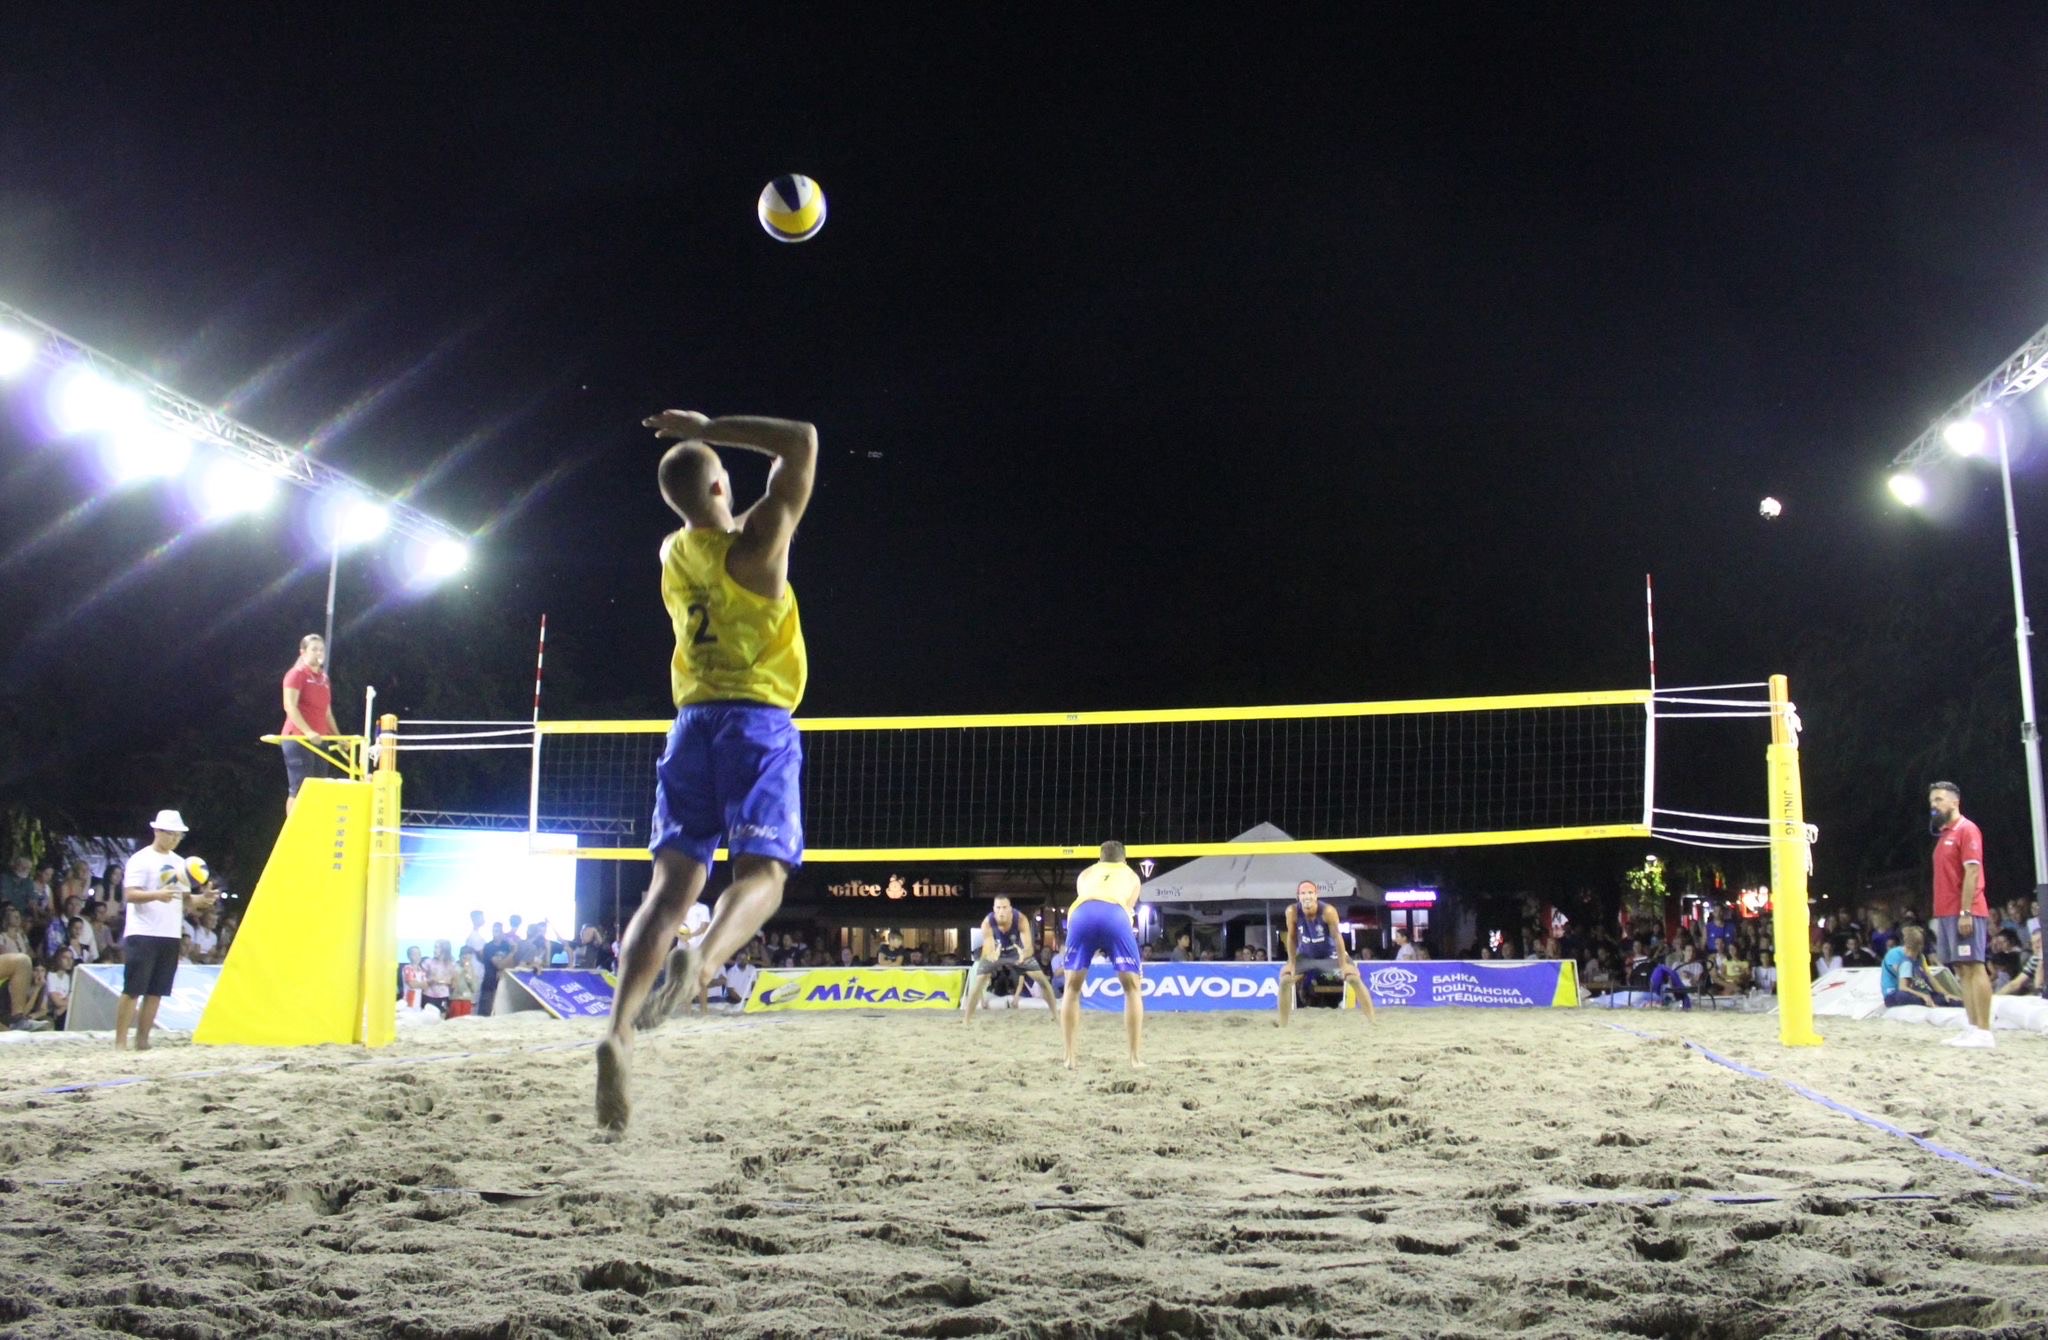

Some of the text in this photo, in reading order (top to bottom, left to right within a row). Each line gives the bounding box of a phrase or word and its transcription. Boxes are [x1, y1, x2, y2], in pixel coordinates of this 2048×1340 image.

[687, 603, 719, 645] 2
[912, 877, 963, 897] time
[1432, 973, 1479, 984] БАНКА
[1432, 983, 1521, 996] ПОШТАНСКА
[1433, 992, 1534, 1005] ШТЕДИОНИЦА
